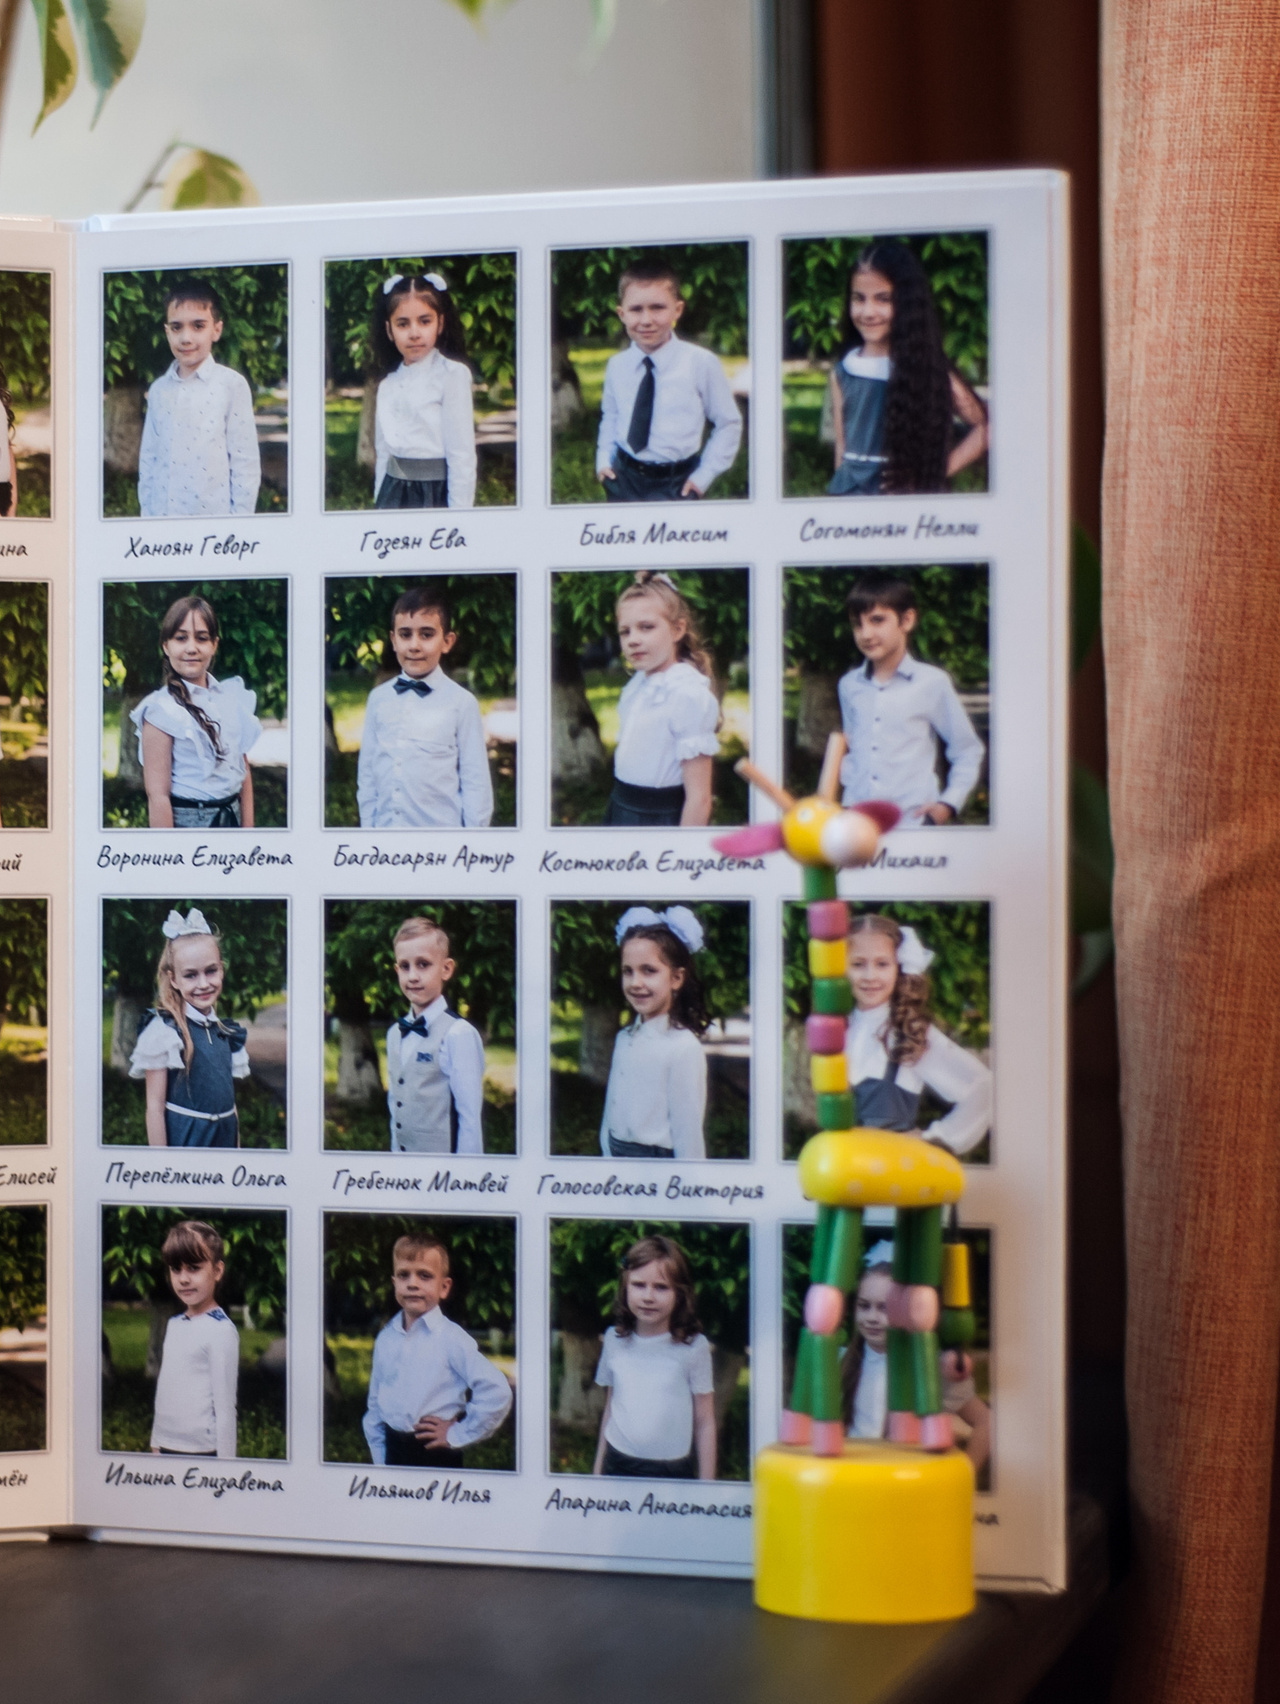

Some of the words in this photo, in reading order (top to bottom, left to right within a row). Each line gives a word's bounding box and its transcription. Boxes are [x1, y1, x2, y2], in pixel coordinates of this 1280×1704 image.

[360, 530, 421, 559] Гозеян
[429, 527, 468, 550] Ева
[579, 522, 637, 547] Библя
[642, 521, 729, 545] Максим
[799, 517, 907, 543] Согомонян
[913, 514, 980, 540] Нелли
[124, 535, 193, 560] Ханоян
[199, 533, 260, 558] Геворг
[96, 845, 185, 873] Воронина
[191, 845, 294, 875] Елизавета
[333, 845, 446, 872] Багдасарян
[452, 845, 516, 873] Артур
[538, 849, 649, 874] Костюкова
[105, 1162, 225, 1190] Перепёлкина
[232, 1165, 288, 1189] Ольга
[332, 1169, 422, 1196] Гребенюк
[427, 1171, 510, 1195] Матвей
[537, 1174, 658, 1198] Голосовская
[665, 1176, 764, 1205] Виктория
[105, 1462, 176, 1486] Ильина
[182, 1467, 286, 1498] Елизавета
[349, 1475, 436, 1500] Ильяшов
[441, 1480, 491, 1504] Илья
[545, 1488, 632, 1517] Апарина
[638, 1492, 752, 1519] Анастасия
